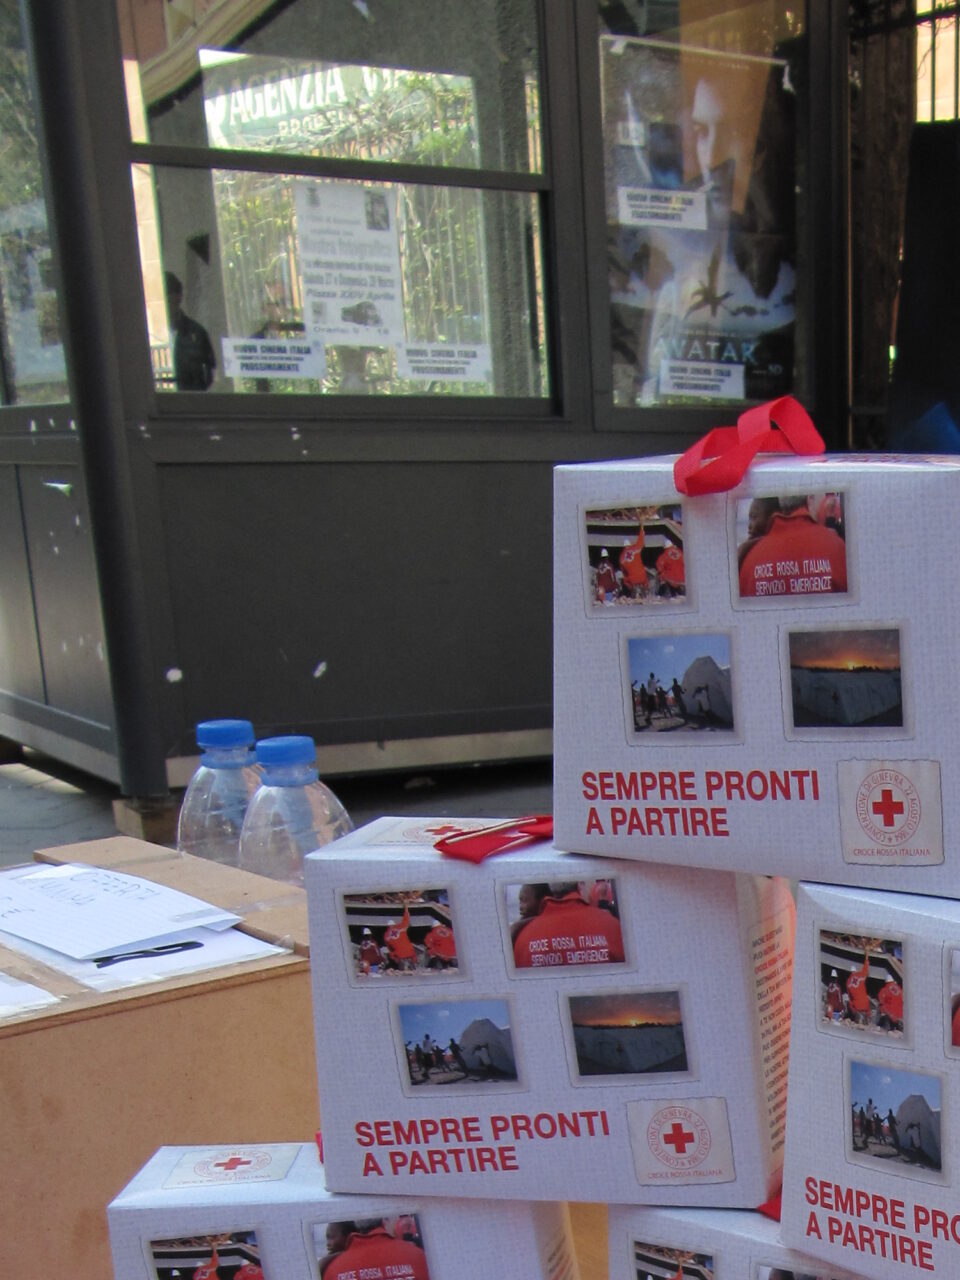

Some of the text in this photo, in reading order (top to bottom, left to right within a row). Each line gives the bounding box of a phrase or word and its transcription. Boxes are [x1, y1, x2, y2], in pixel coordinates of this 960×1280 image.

[755, 559, 832, 579] CROCE ROSSA ITALIANA
[756, 576, 832, 597] SERVIZIO EMERGENZE
[582, 770, 818, 800] SEMPRE PRONTI
[587, 807, 728, 836] A PARTIRE
[355, 1111, 608, 1146] SEMPRE PRONTI
[364, 1146, 517, 1176] A PARTIRE
[806, 1177, 904, 1228] SEMPRE
[807, 1212, 933, 1270] A PARTIRE
